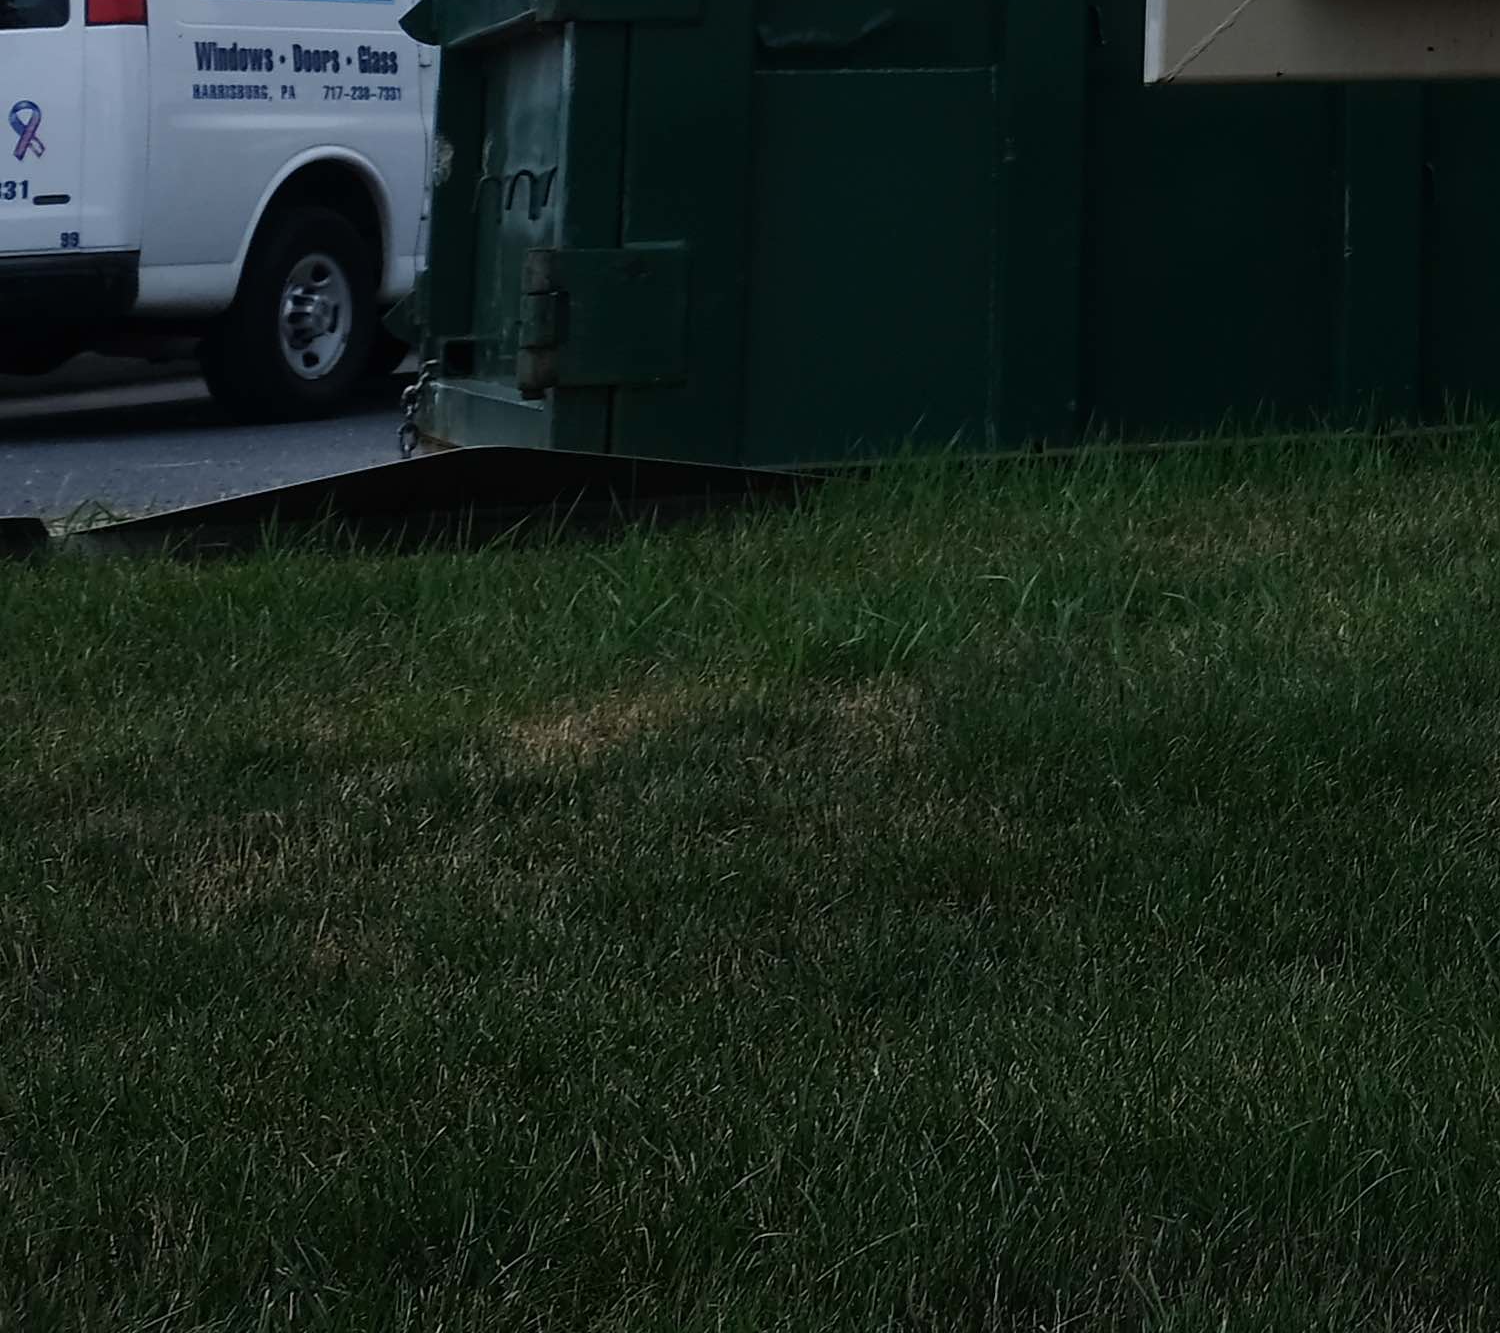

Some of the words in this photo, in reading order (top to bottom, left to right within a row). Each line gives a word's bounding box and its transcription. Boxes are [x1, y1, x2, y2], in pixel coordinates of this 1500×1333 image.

[194, 41, 274, 72] Windows
[292, 43, 340, 73] Doors
[357, 44, 398, 74] Glass
[280, 85, 296, 100] PA
[0, 180, 29, 201] 31
